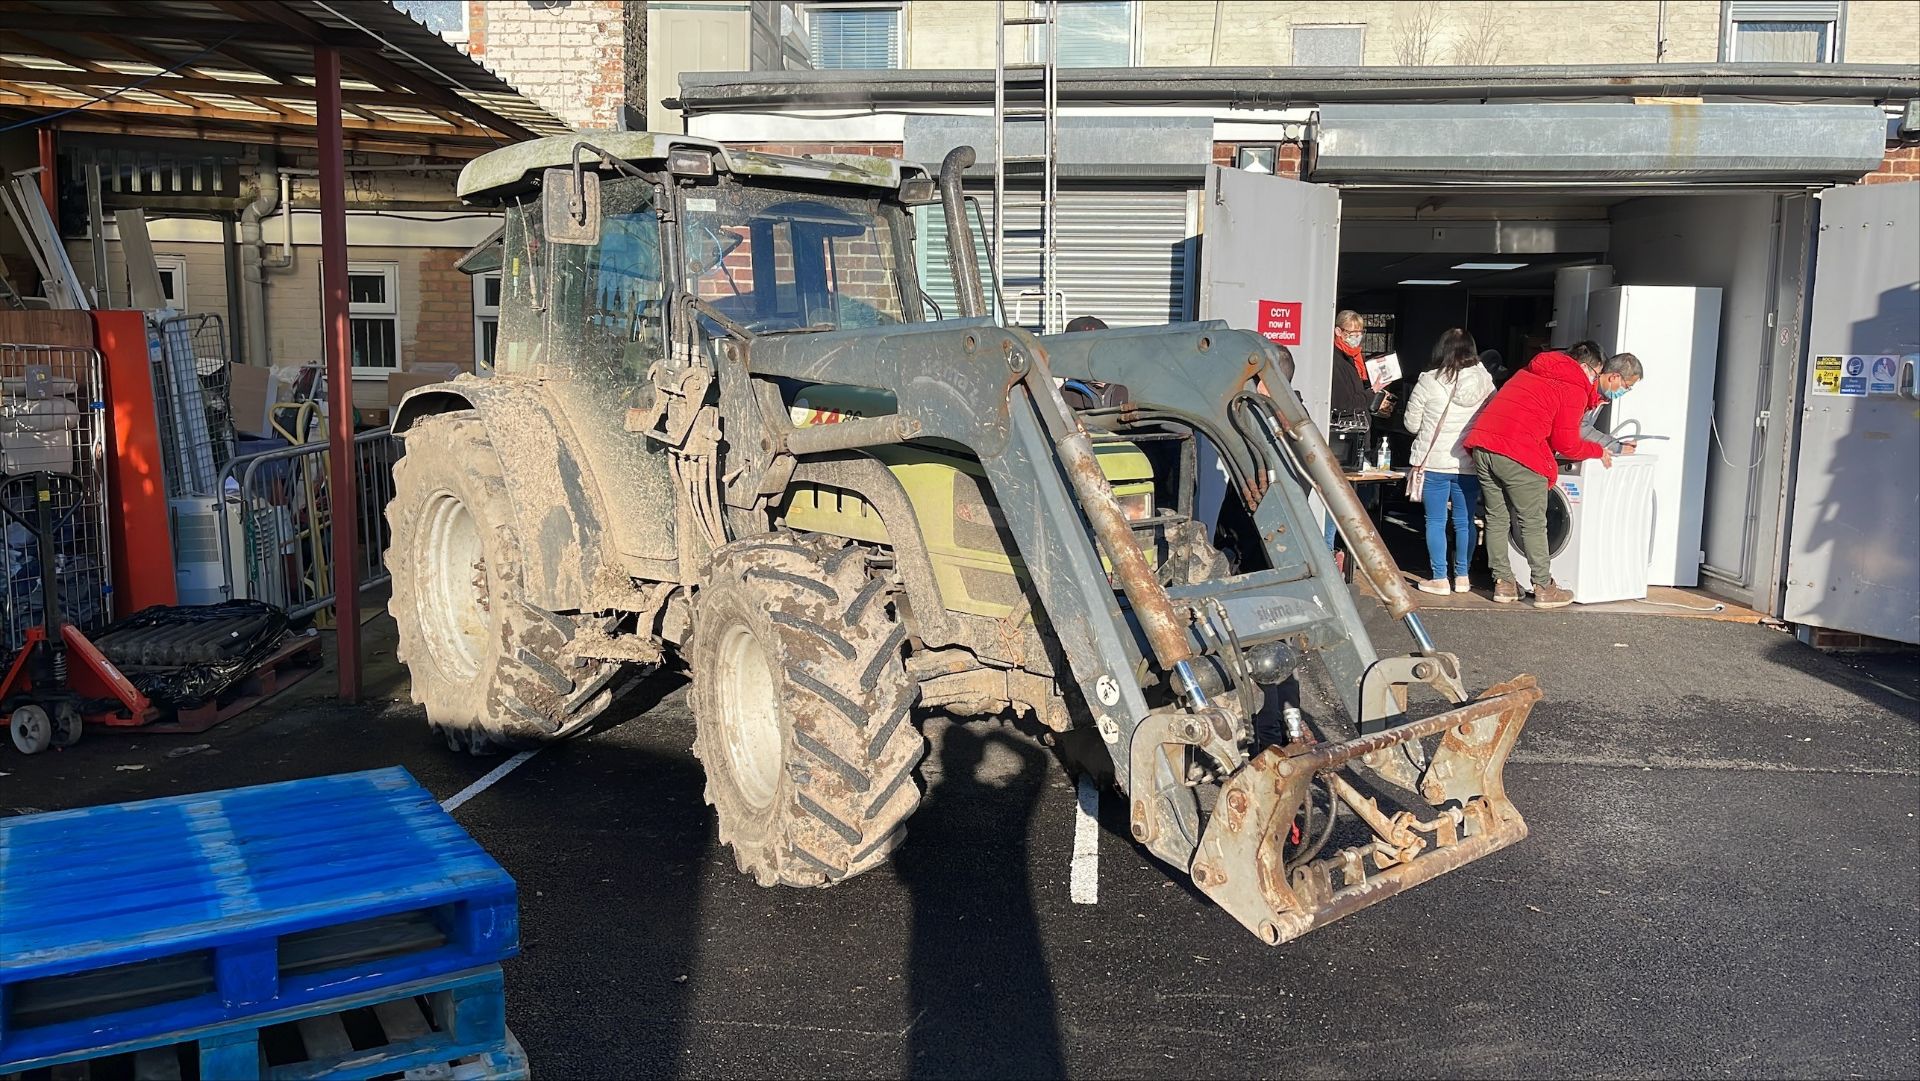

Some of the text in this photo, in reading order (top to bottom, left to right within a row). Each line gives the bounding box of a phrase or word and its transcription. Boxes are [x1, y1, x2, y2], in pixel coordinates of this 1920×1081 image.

[1271, 308, 1290, 317] CCTV
[1284, 320, 1291, 328] in
[809, 406, 840, 425] XA
